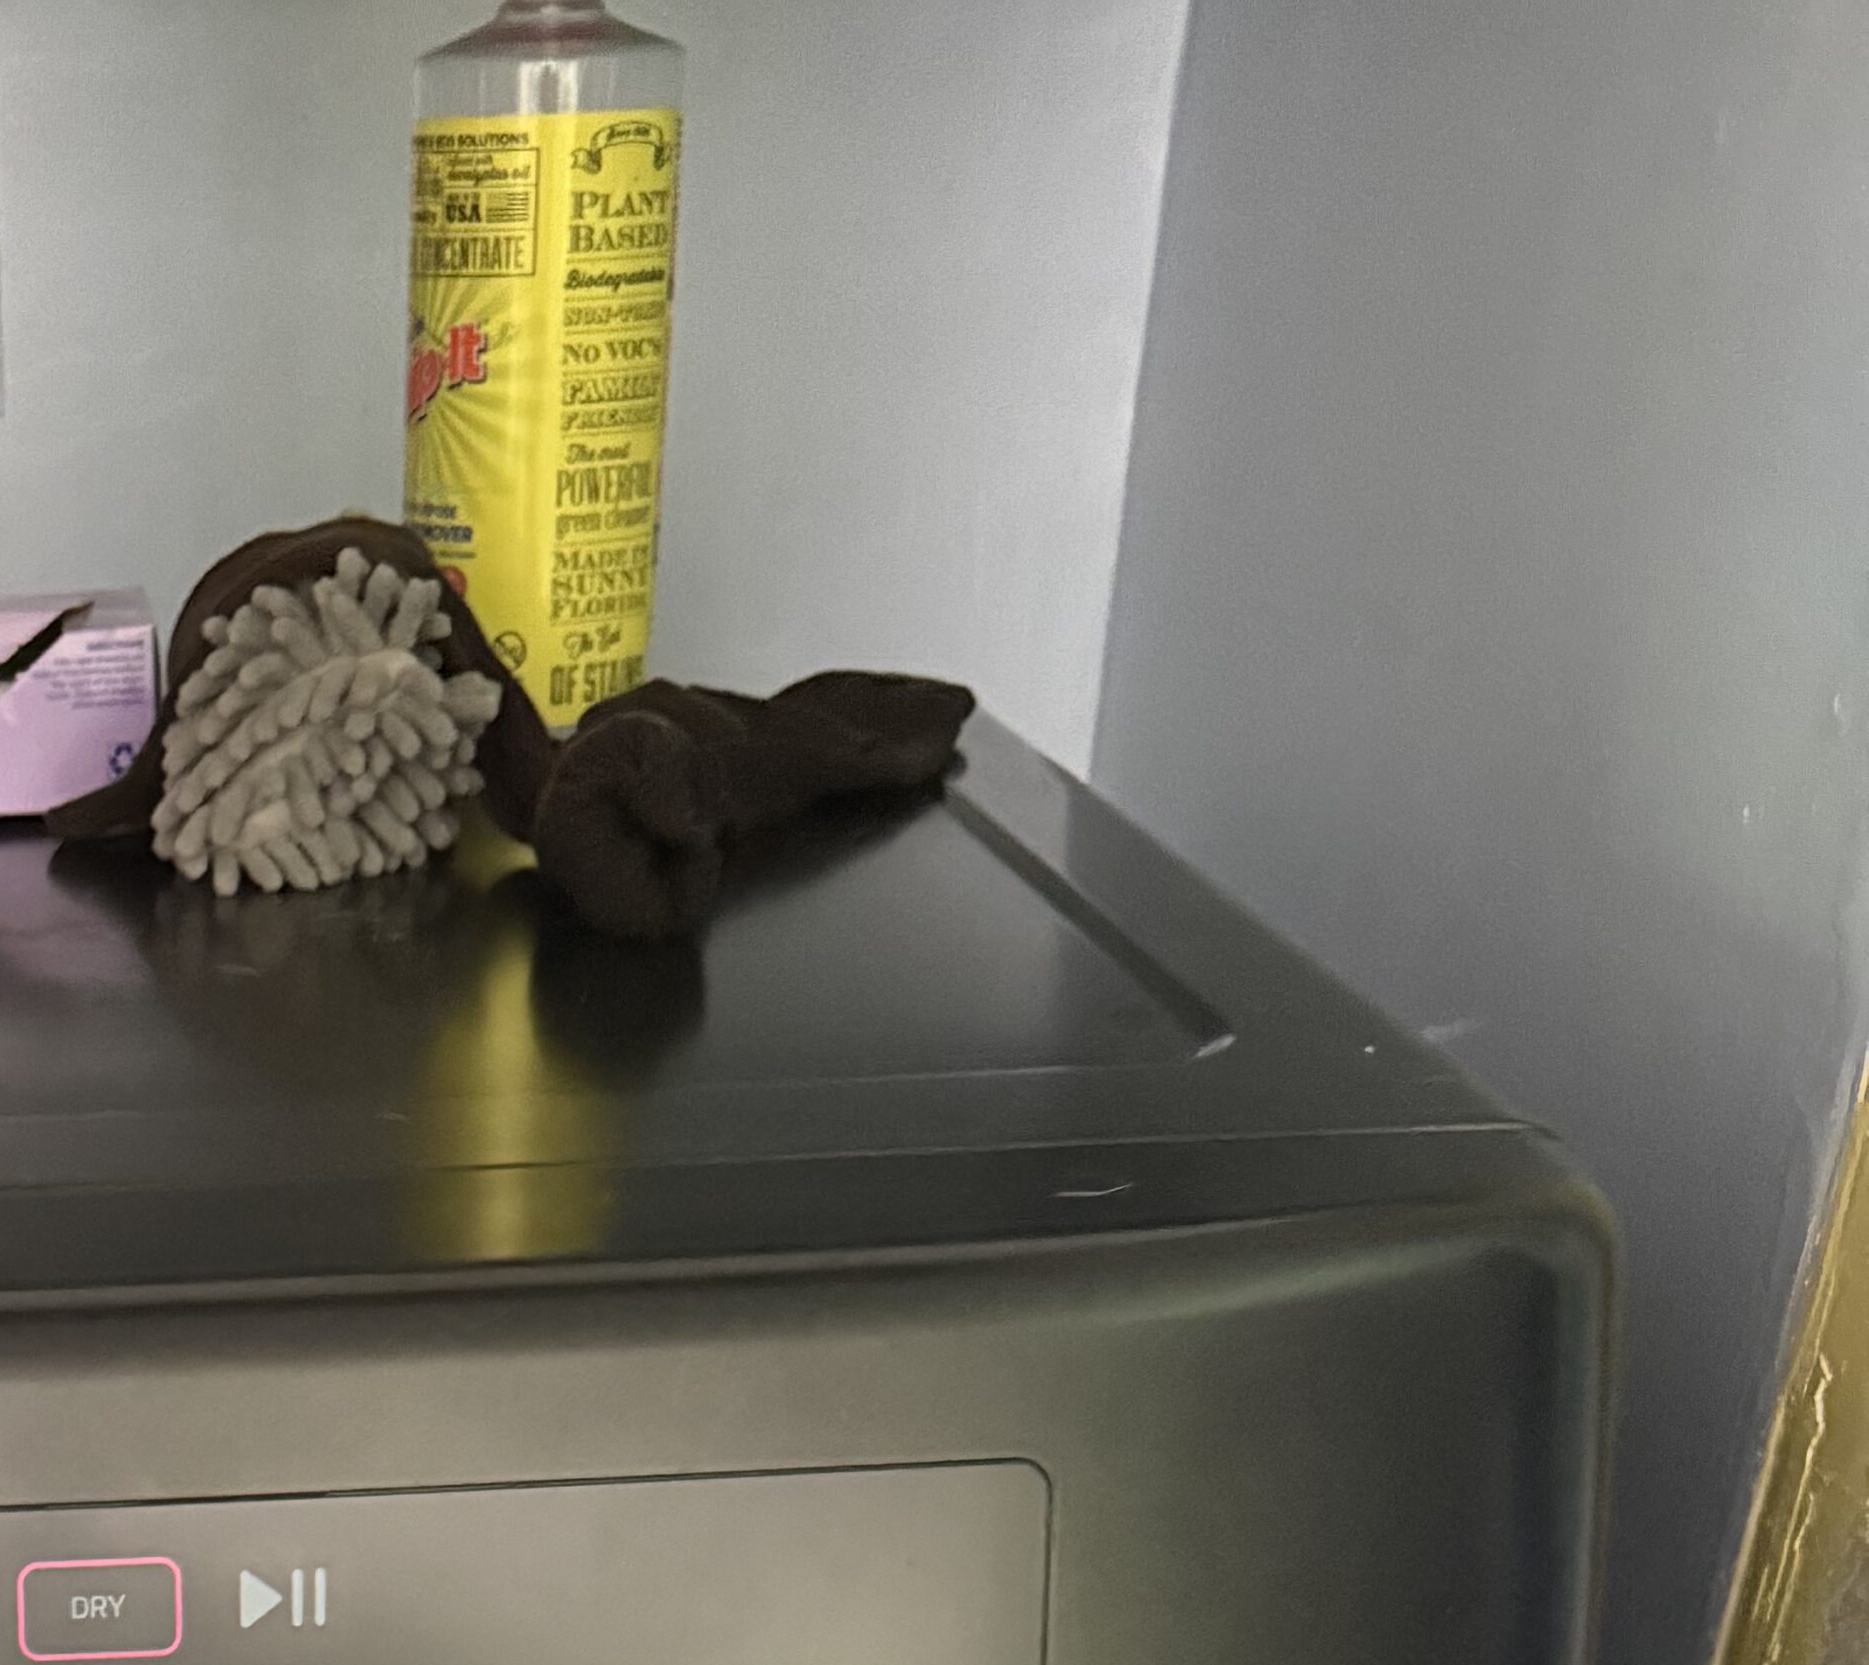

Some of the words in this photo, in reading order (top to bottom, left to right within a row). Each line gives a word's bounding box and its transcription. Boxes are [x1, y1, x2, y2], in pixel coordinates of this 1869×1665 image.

[457, 133, 529, 147] SOLUTIONS
[445, 203, 481, 224] USA
[570, 189, 669, 220] PLANT
[567, 223, 668, 253] BASED
[562, 344, 600, 365] NO
[550, 662, 579, 705] OF
[70, 1594, 127, 1622] DRY
